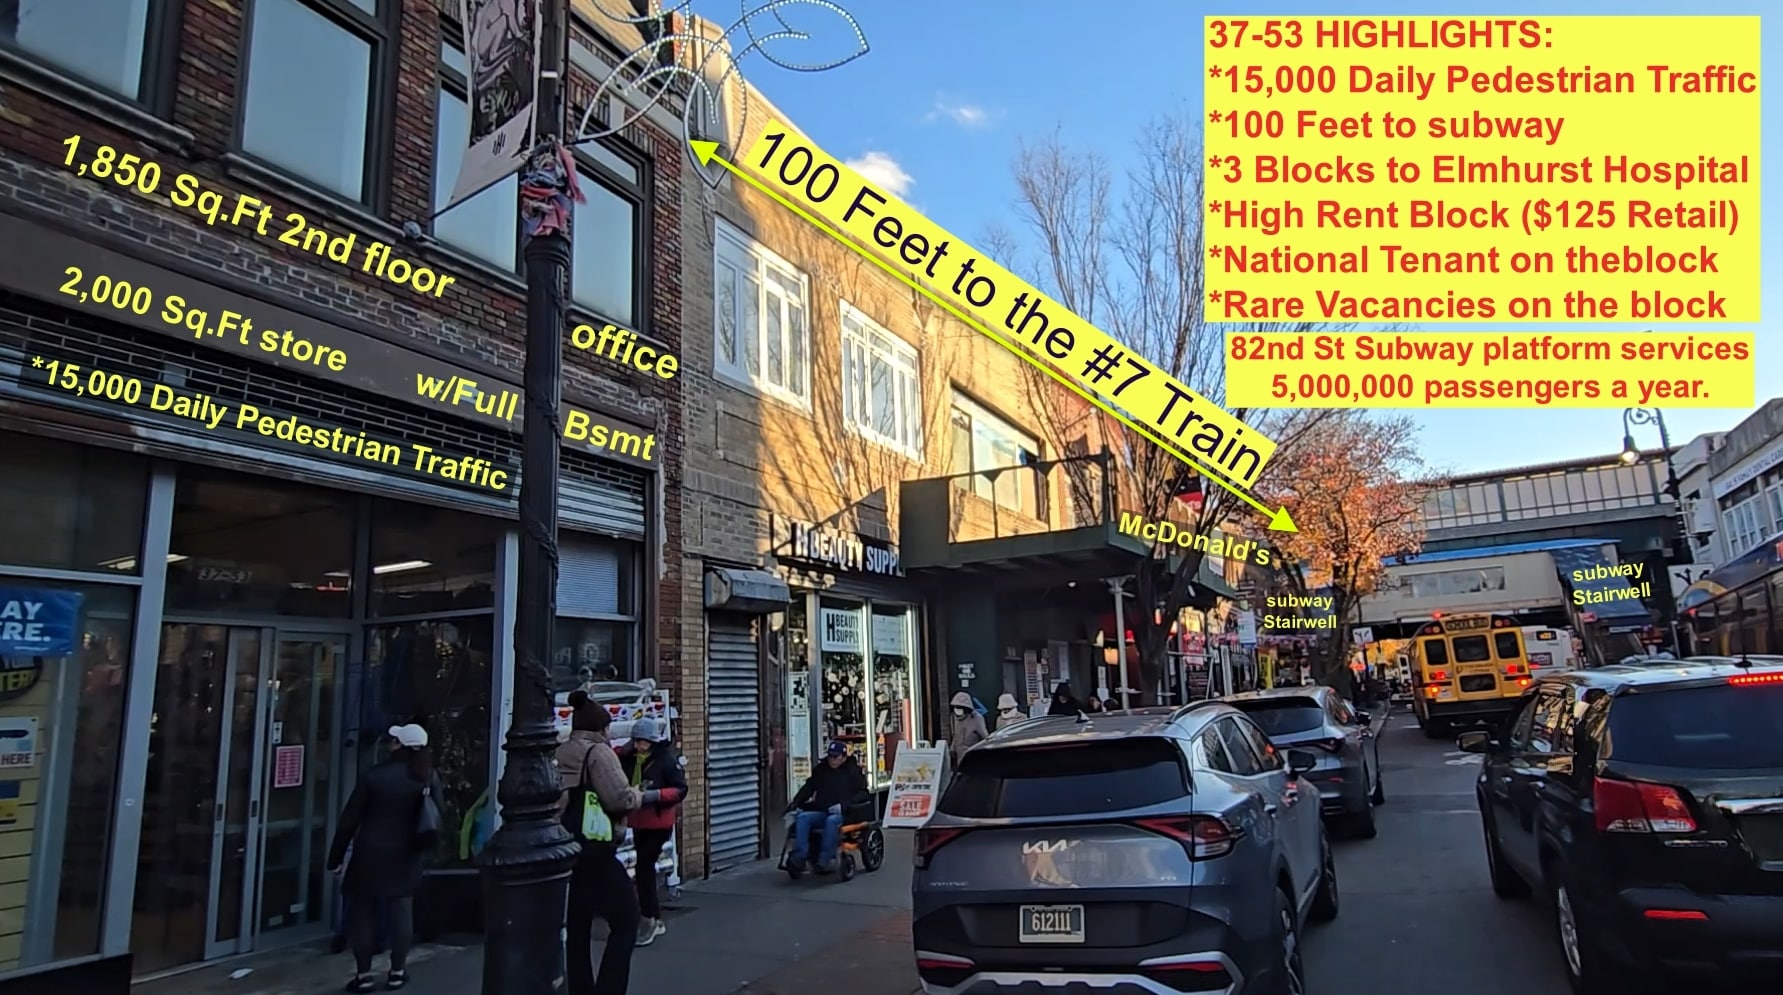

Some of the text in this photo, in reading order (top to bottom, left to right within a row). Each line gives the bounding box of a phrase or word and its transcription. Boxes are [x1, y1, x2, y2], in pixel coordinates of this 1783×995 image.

[810, 529, 863, 572] BEAUTY
[0, 622, 51, 643] RE.
[826, 612, 836, 643] H
[1, 753, 32, 766] HERE
[1032, 912, 1072, 932] 612111
